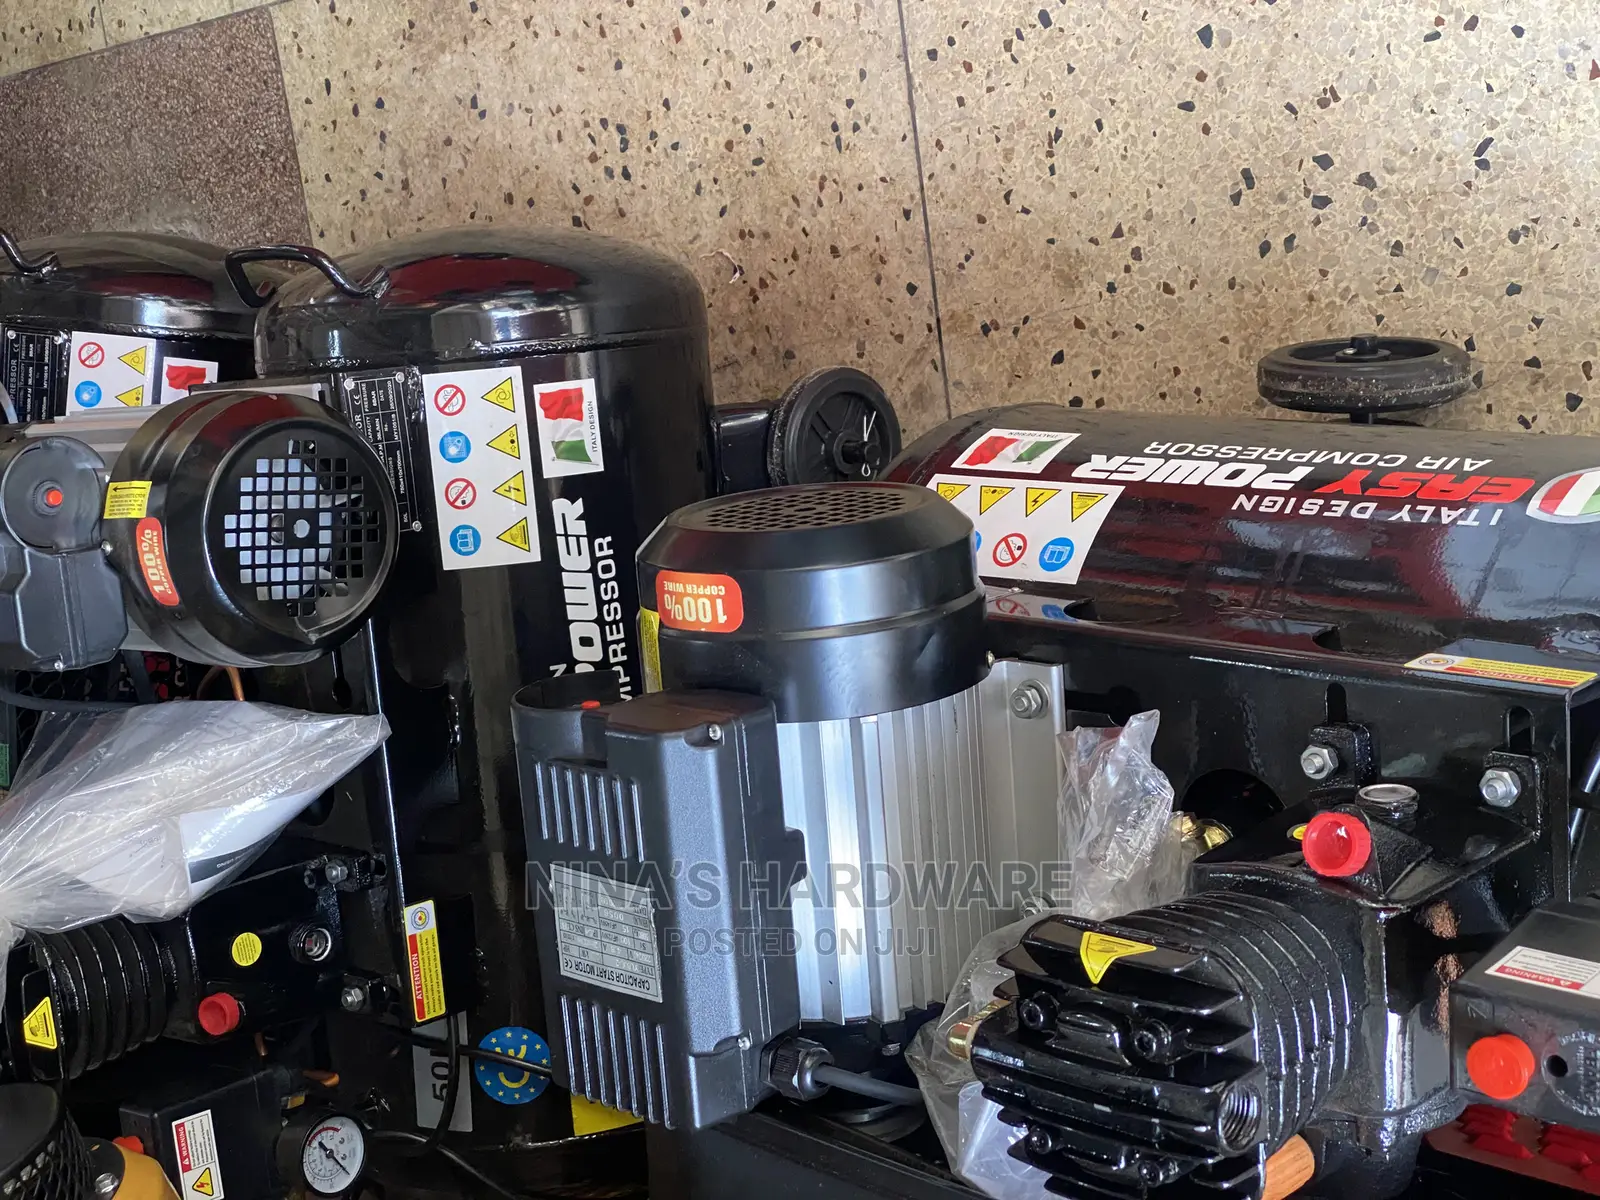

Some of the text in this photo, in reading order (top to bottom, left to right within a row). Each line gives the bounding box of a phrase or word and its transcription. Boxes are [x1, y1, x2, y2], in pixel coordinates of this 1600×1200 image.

[590, 432, 598, 452] ITALY
[1143, 441, 1493, 472] AIR COMPRESSOR
[1071, 454, 1536, 503] EASY POWER
[1231, 493, 1504, 526] ITALY DESIGN
[141, 529, 165, 593] 100%
[152, 531, 172, 595] COPPER WIRE
[663, 580, 726, 596] COPPER WIRE
[663, 594, 728, 624] 100%
[412, 953, 423, 999] ATTENTION
[563, 957, 572, 969] CE
[574, 959, 595, 976] MOTOR
[595, 965, 614, 981] START
[614, 970, 650, 991] CAPACITOR
[179, 1127, 188, 1156] WARNING
